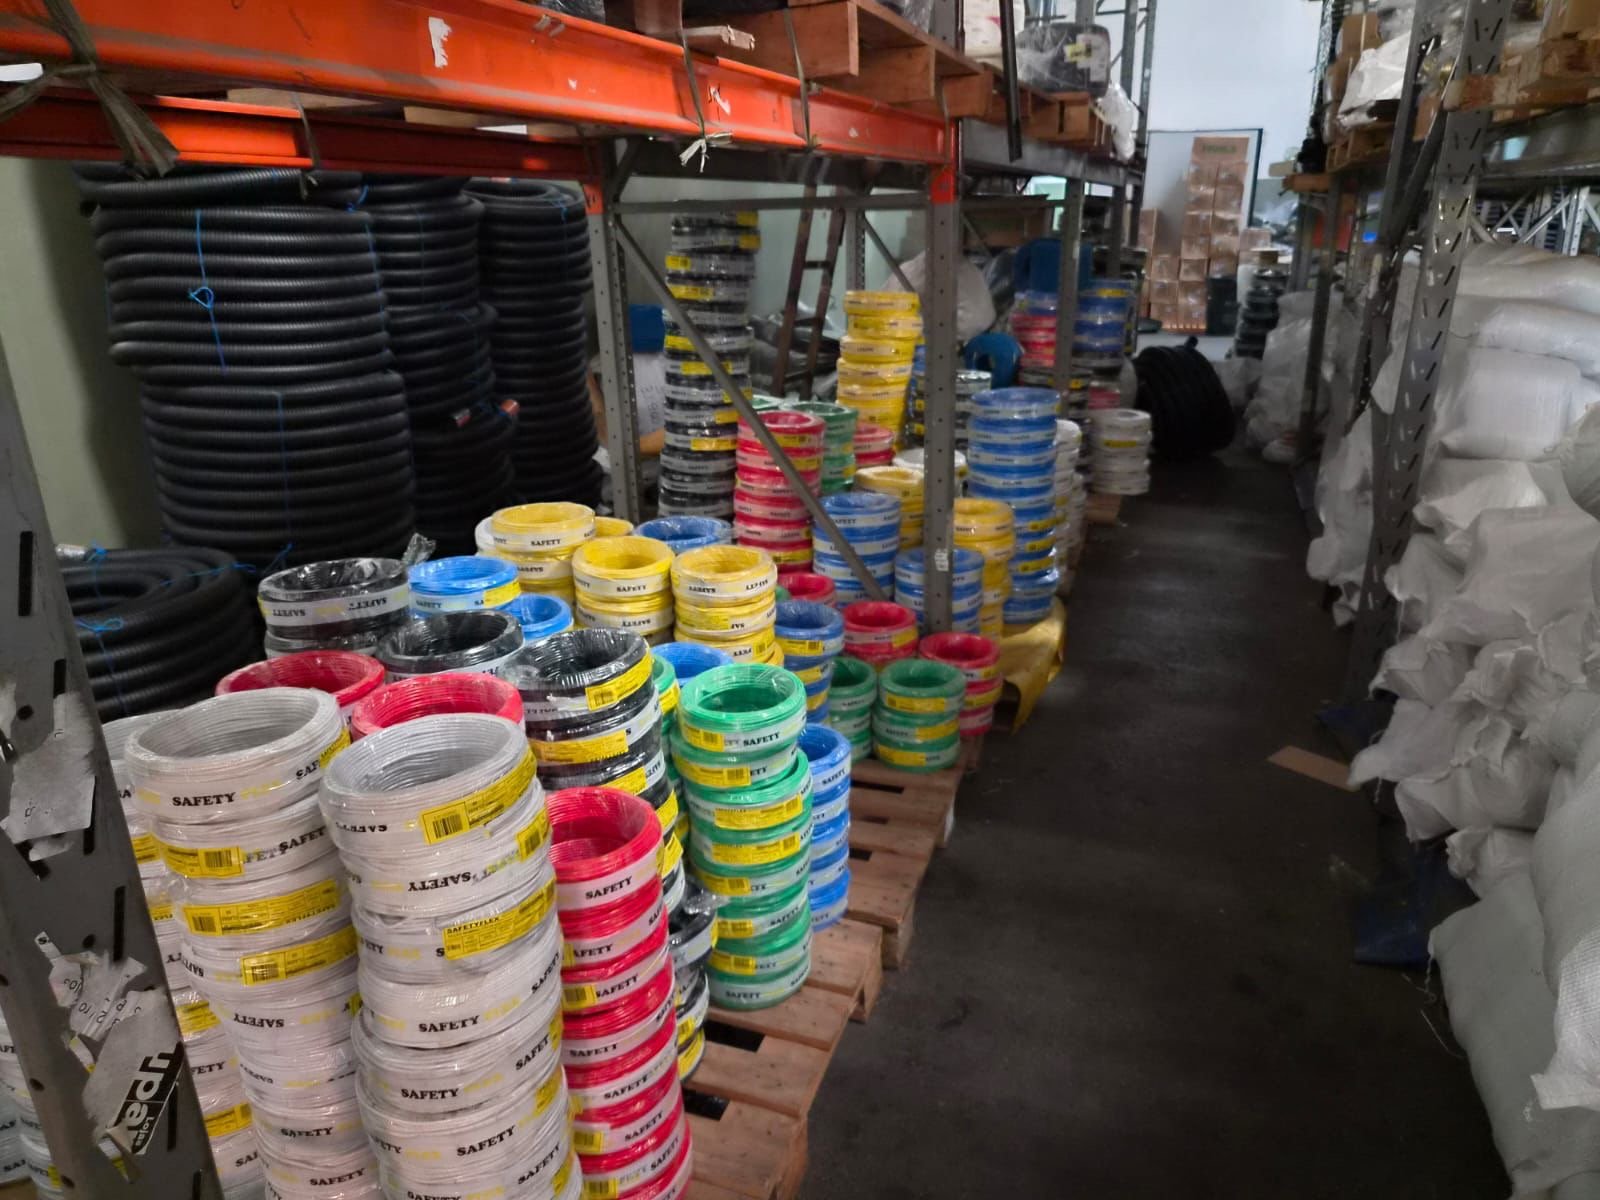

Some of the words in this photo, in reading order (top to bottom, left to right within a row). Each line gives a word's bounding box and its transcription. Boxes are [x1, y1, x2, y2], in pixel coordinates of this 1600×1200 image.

[832, 517, 856, 525] AFETY
[530, 538, 561, 546] SAFETY
[617, 584, 647, 593] SAFETY
[743, 732, 780, 747] SAFETY
[295, 758, 320, 780] SAF
[749, 766, 768, 777] ETY
[821, 769, 846, 786] SAFETY
[172, 792, 236, 807] SAFETY
[279, 826, 328, 852] SAFET
[407, 871, 471, 892] SAFETY
[585, 876, 632, 900] SAFETY
[446, 917, 500, 935] SAFETYFLEX
[573, 943, 613, 958] AFETY
[725, 990, 761, 999] SAFETY
[233, 1012, 285, 1028] SAFETY
[418, 1015, 480, 1033] SAFETY
[515, 1034, 550, 1071] SAFET
[569, 1043, 618, 1058] SAFETY
[401, 1088, 459, 1100] SAFETY
[604, 1074, 649, 1100] SAFETY
[280, 1127, 334, 1138] SAFETY
[625, 1110, 664, 1141] SAFETY
[457, 1125, 516, 1157] SAFETY
[650, 1137, 680, 1171] SAFETY
[517, 1142, 561, 1185] SAFETY
[309, 1167, 366, 1186] SAFETY
